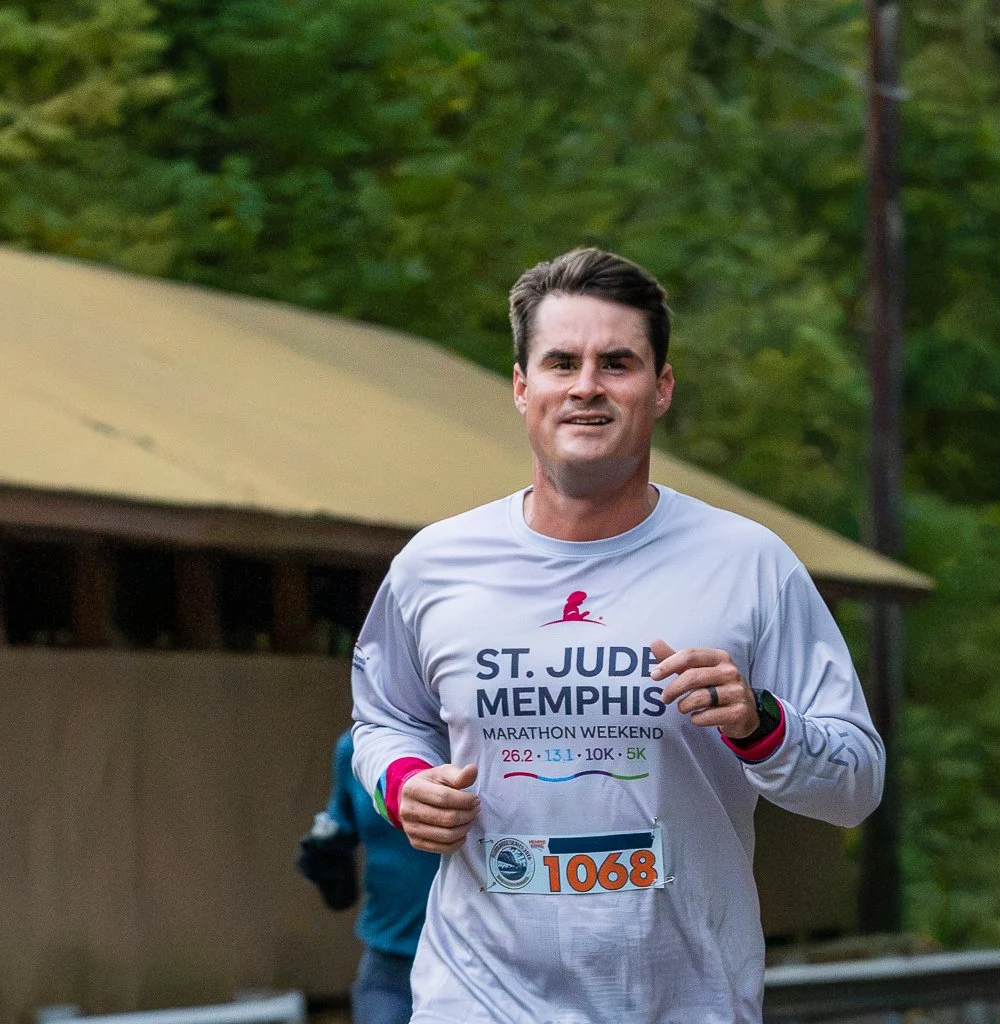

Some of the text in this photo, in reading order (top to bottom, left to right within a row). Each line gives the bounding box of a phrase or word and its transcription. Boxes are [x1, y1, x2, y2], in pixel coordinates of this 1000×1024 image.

[475, 647, 535, 681] ST.
[476, 685, 668, 719] MEMPHIS
[482, 725, 665, 741] MARATHON WEEKEND
[501, 747, 648, 763] 26.2 13.1 10K 5K
[543, 849, 659, 893] 1068
